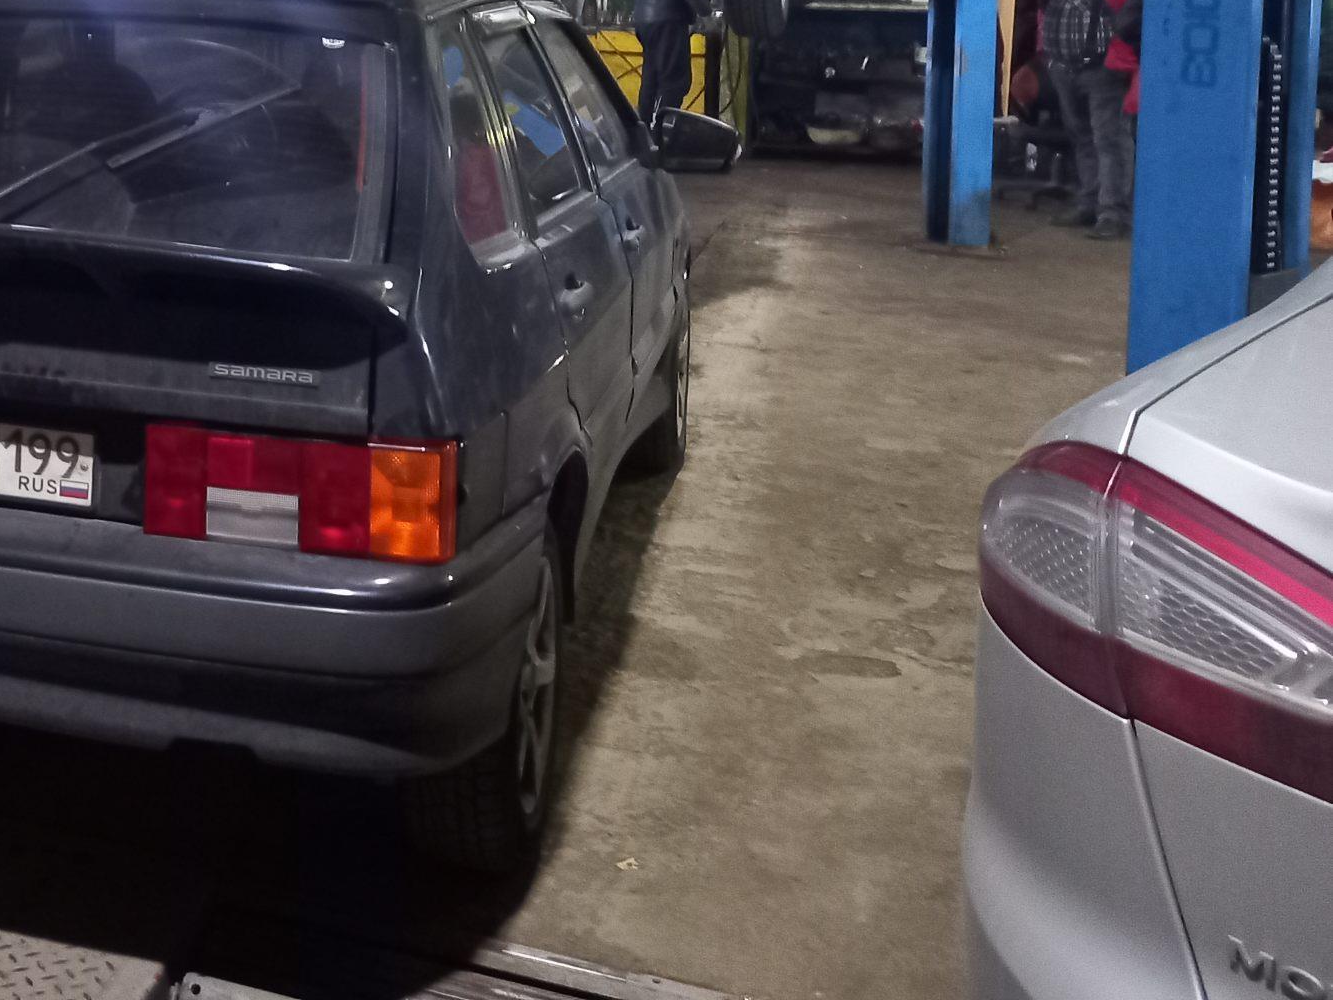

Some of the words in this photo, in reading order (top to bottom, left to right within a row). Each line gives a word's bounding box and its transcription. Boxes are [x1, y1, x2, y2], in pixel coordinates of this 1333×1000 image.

[3, 428, 80, 479] 199
[18, 475, 58, 495] RUS
[1227, 934, 1333, 1000] MO
